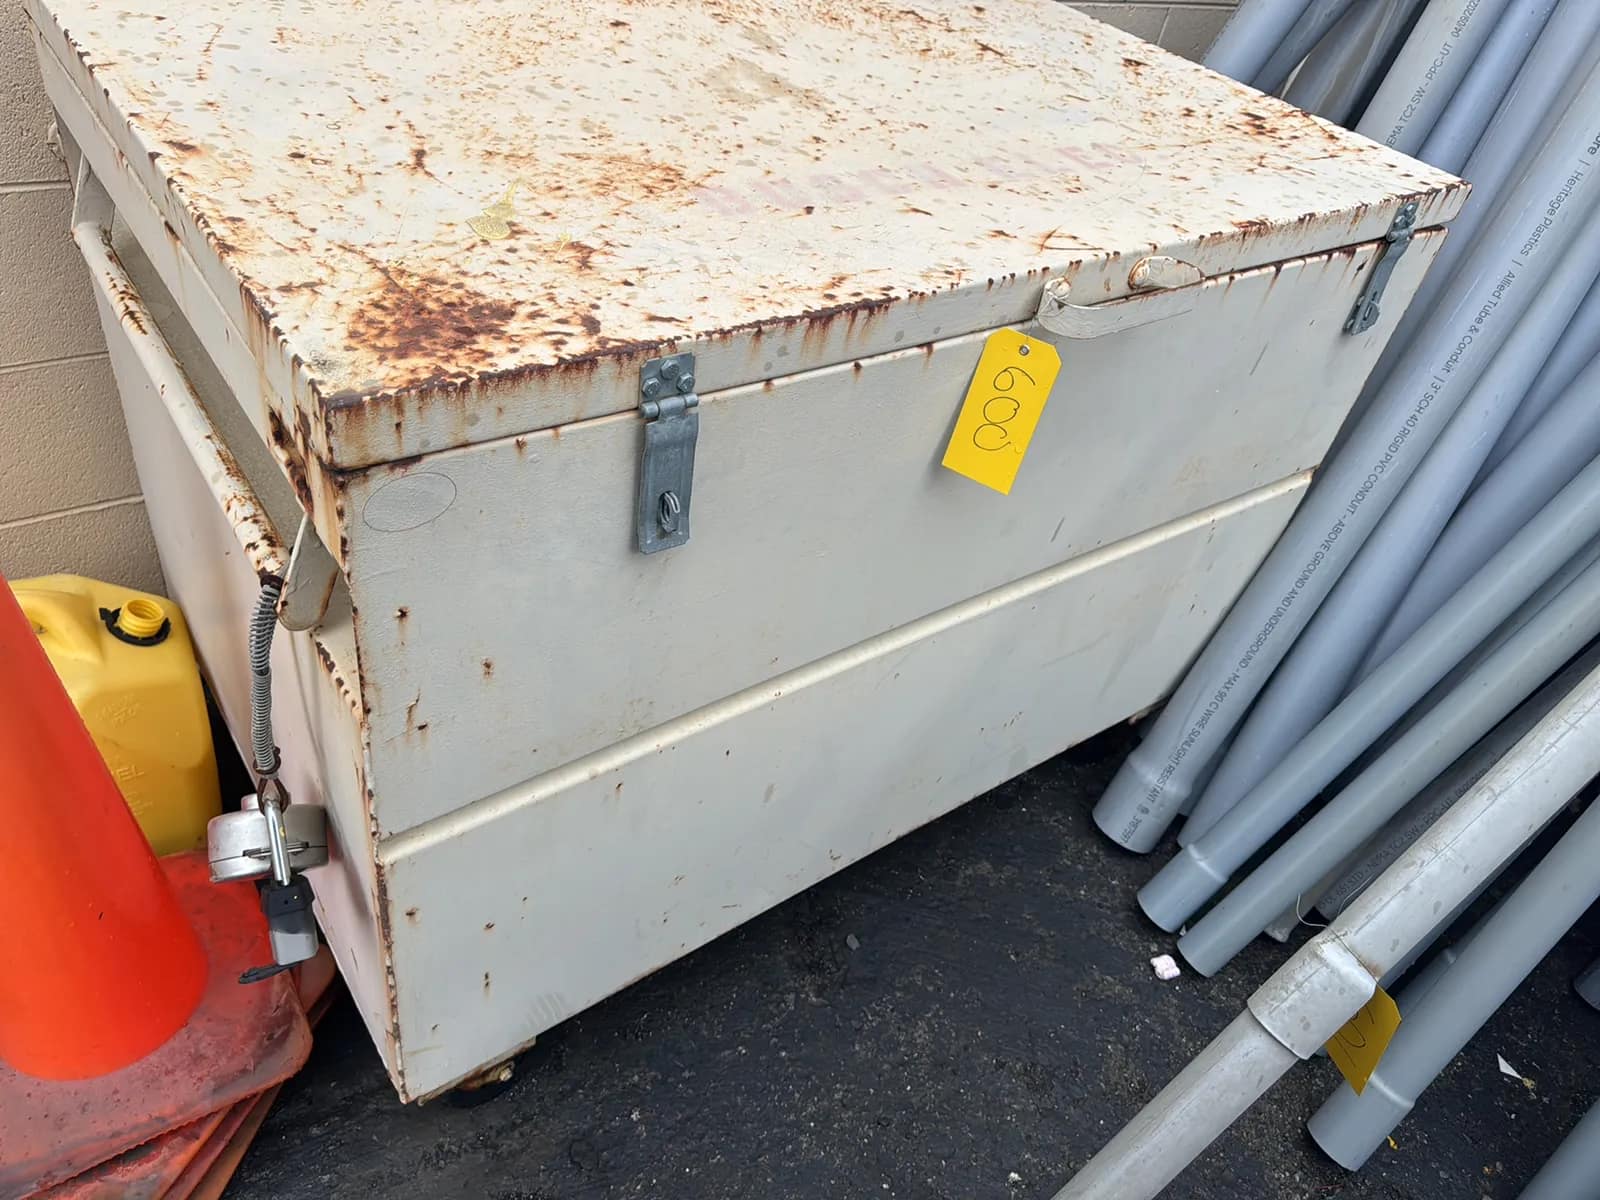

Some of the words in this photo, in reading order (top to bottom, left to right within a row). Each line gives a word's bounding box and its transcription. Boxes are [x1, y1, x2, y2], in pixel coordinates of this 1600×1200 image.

[1398, 102, 1416, 124] TC2
[1410, 86, 1426, 104] SW
[1423, 41, 1454, 80] PPC-UT
[1448, 0, 1481, 38] 04/09/202
[1544, 166, 1583, 219] Heritage
[1519, 214, 1552, 258] Plastics
[1491, 268, 1516, 300] Allied
[1474, 297, 1497, 326] Tube
[1441, 332, 1474, 375] Conduit
[1413, 390, 1434, 415] SCH
[1404, 412, 1420, 428] 40
[1387, 425, 1410, 453] RIGID
[1373, 451, 1392, 474] PVC
[1346, 471, 1379, 514] CONDUIT
[1319, 519, 1345, 552] ABOVE
[1293, 549, 1325, 590] GROUND
[1280, 586, 1299, 608] AND
[1237, 604, 1286, 670] UNDERGROUND
[1213, 689, 1226, 702] 90
[1221, 671, 1239, 691] MAX
[1195, 708, 1214, 729] WIRE
[1208, 700, 1219, 710] C
[1169, 727, 1201, 766] SUNLIGHT
[1144, 764, 1177, 803] RESISTANT
